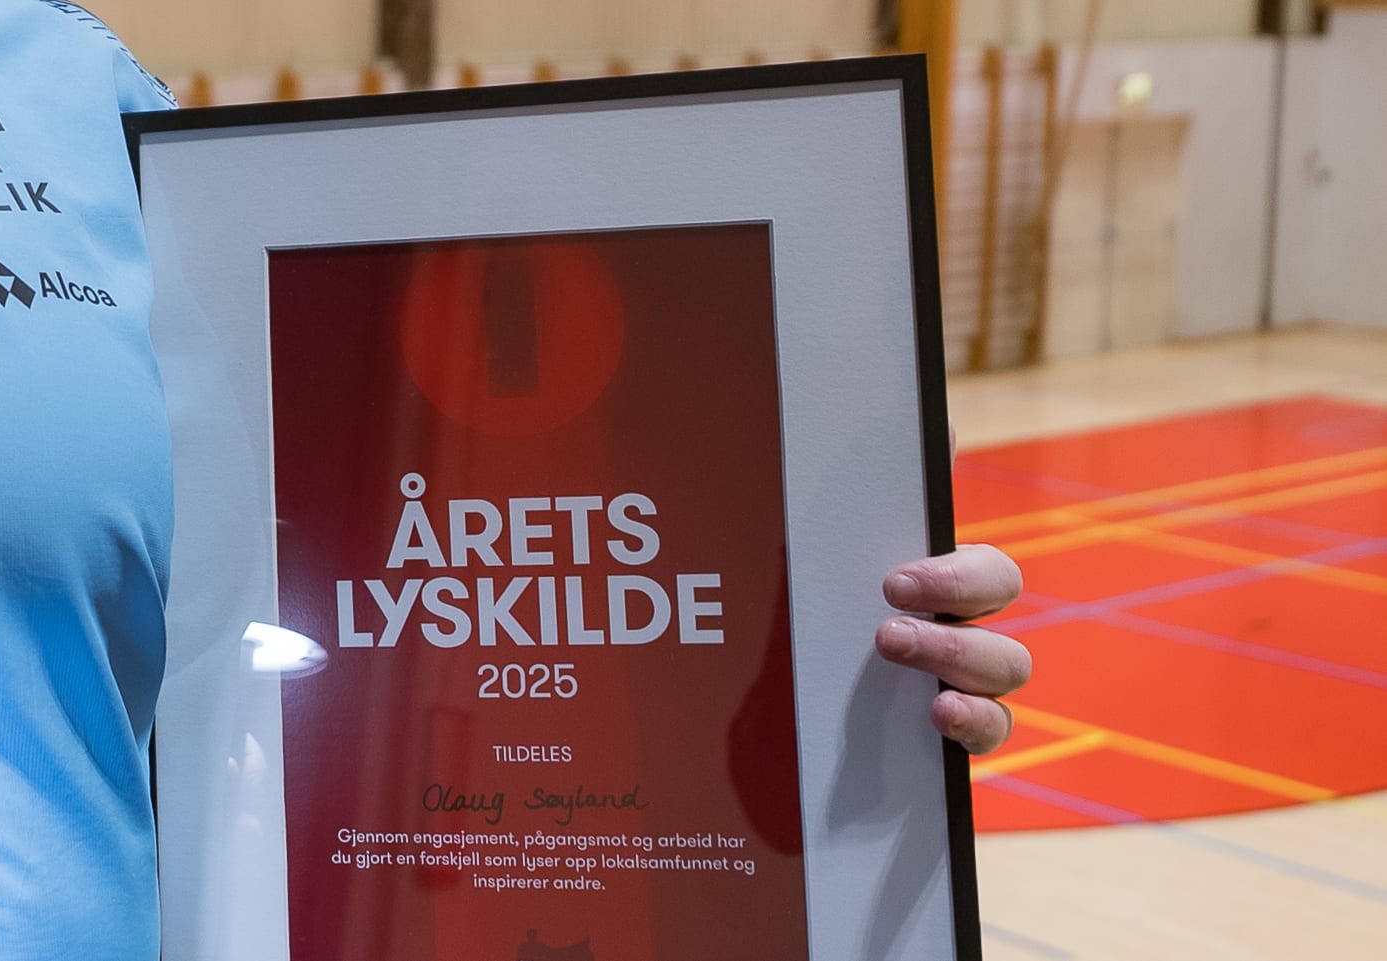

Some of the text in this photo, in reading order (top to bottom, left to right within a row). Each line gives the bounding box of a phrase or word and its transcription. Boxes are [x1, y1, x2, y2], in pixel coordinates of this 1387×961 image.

[38, 271, 117, 307] Alcoa
[386, 472, 660, 569] ÅRETS
[336, 573, 725, 648] LYSKILDE
[477, 663, 578, 700] 2025
[493, 745, 572, 763] TILDELES
[422, 783, 649, 826] Olaug Søyland
[337, 828, 746, 852] Gjennom engasjement, pågangsmot og arbeid har
[331, 850, 755, 875] du gjort en forskjell som lyser opp lokalsamfunnet og
[473, 873, 605, 892] inspirerer andre.
